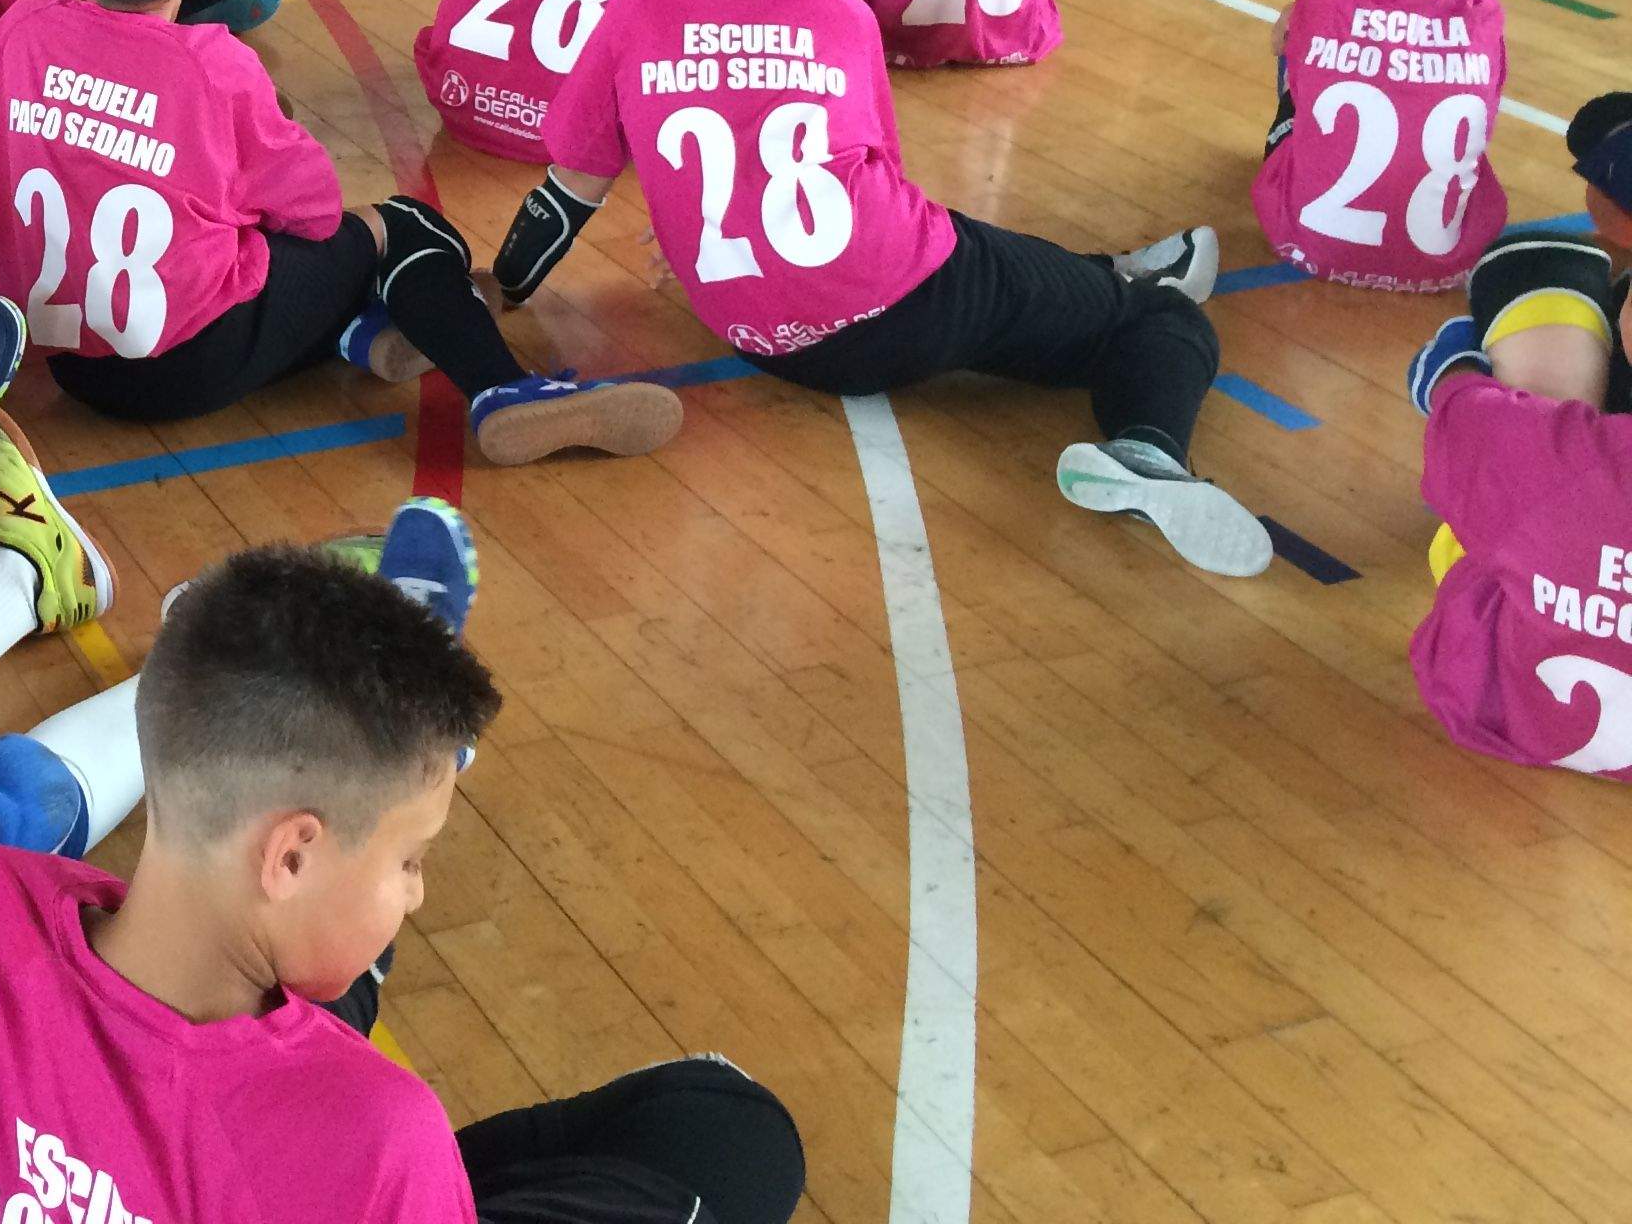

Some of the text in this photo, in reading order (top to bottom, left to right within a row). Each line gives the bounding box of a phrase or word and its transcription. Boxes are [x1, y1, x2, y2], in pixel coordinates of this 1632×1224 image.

[683, 23, 814, 59] ESCUELA
[1304, 36, 1383, 78] PACO
[43, 64, 159, 128] ESCUELA
[475, 82, 549, 113] LA CALLE
[640, 58, 847, 98] PACO SEDANO
[8, 98, 176, 178] PACO SEDANO
[1298, 80, 1488, 256] 28
[656, 102, 854, 284] 28
[13, 167, 174, 359] 28
